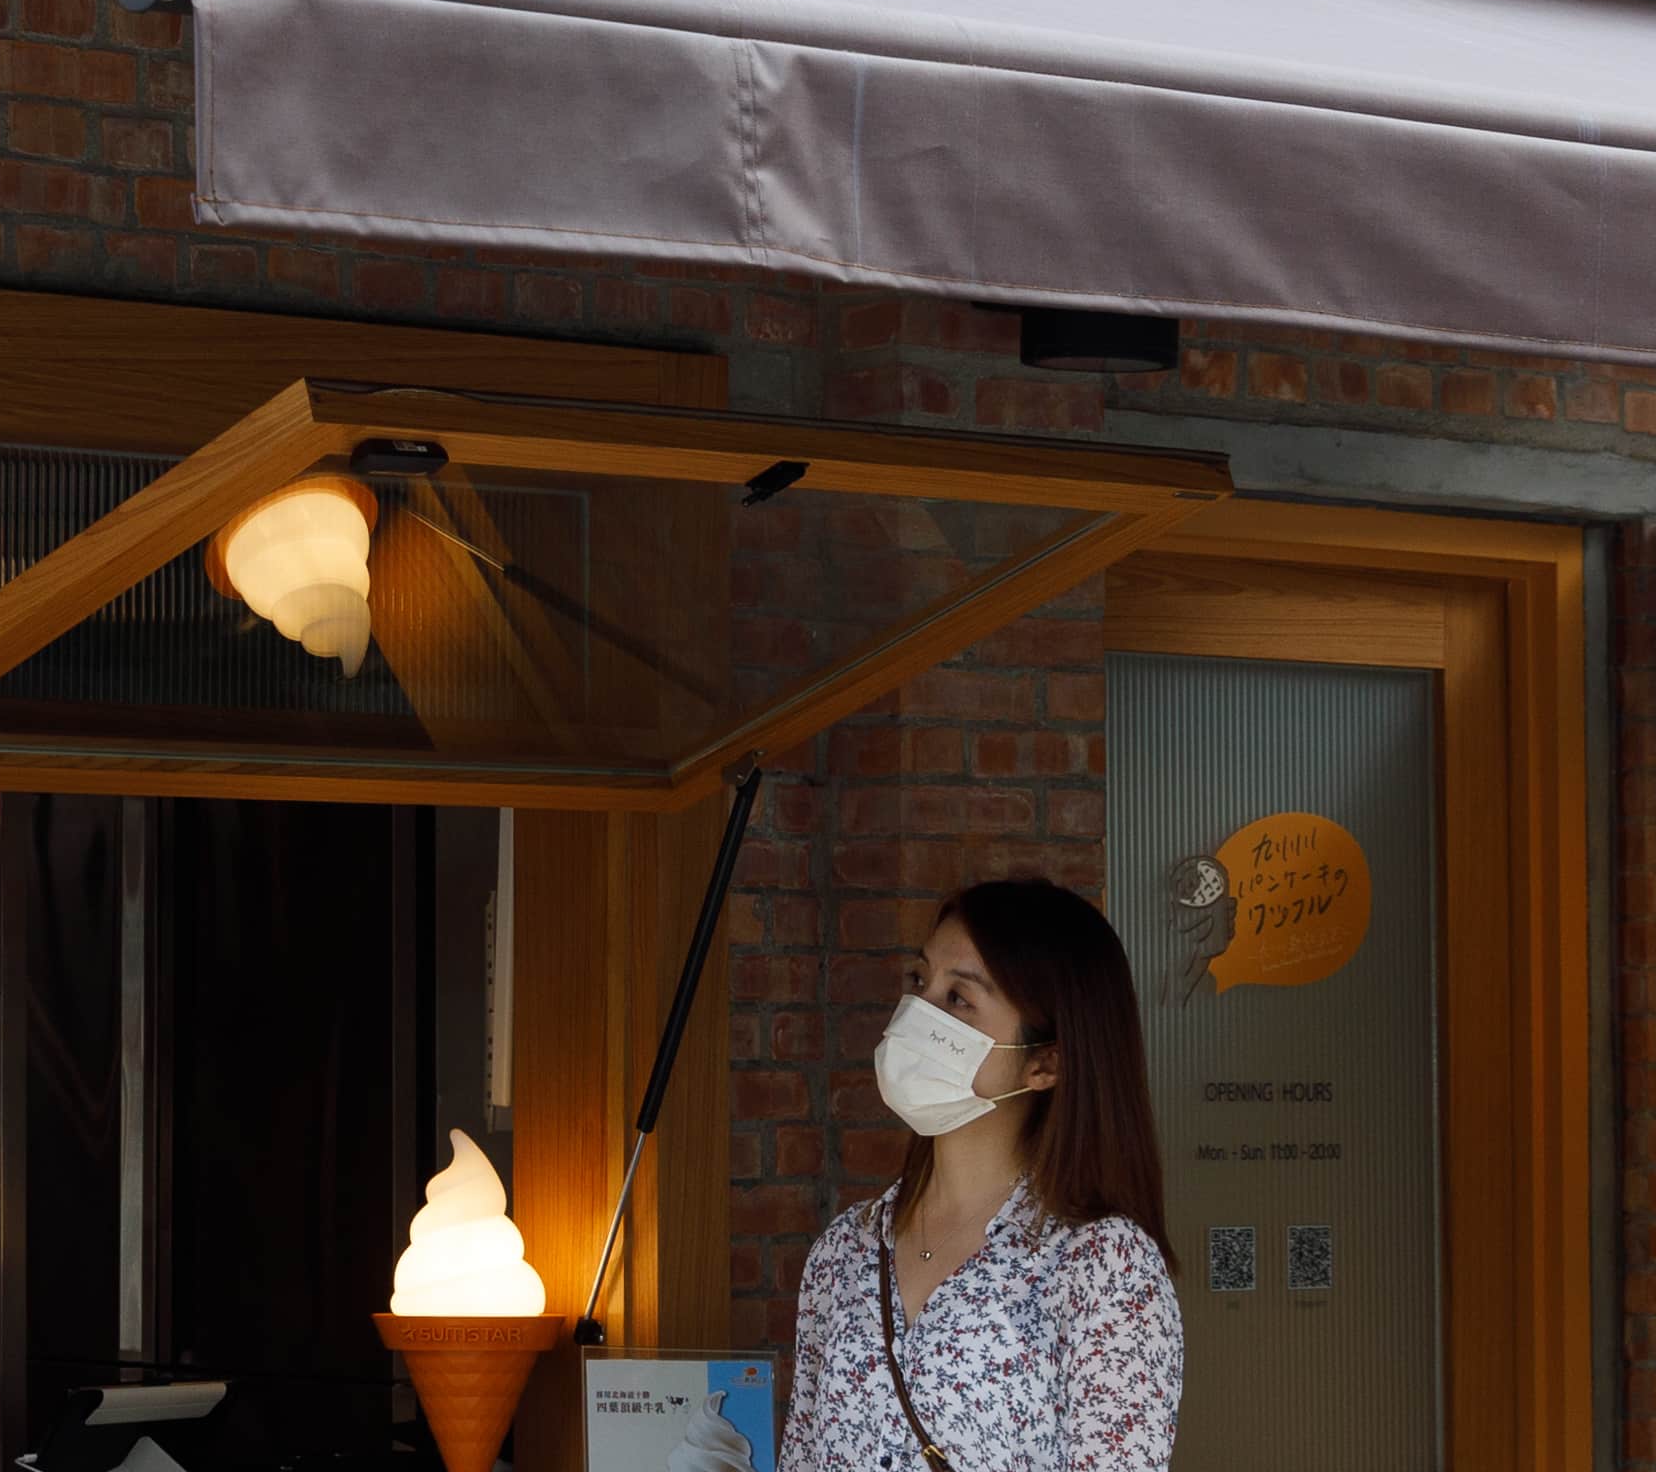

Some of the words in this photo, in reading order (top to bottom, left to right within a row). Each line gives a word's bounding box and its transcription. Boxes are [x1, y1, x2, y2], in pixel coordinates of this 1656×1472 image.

[1238, 864, 1348, 899] パンケーキの
[1248, 895, 1333, 935] ワッフル
[1204, 1082, 1273, 1103] OPENING
[1282, 1082, 1333, 1103] HOURS
